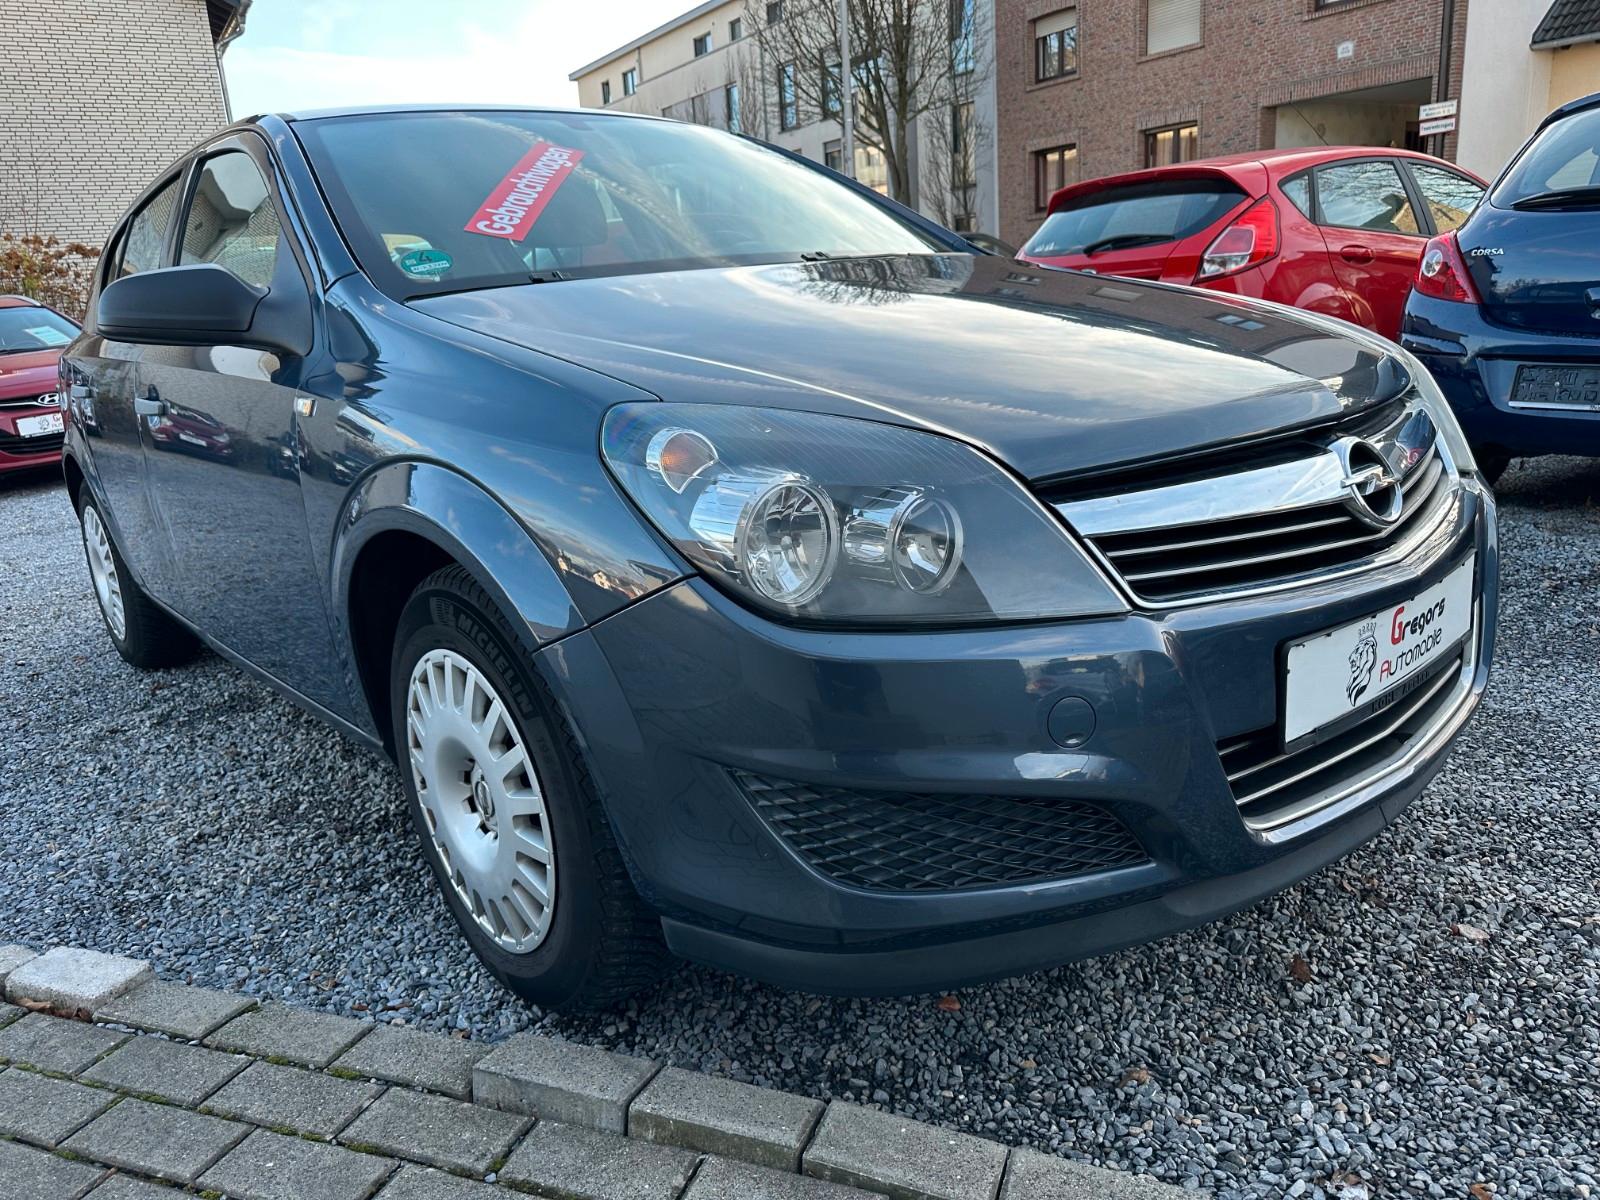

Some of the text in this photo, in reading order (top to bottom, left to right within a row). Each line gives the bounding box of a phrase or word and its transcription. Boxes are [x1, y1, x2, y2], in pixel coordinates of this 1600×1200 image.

[476, 147, 573, 235] Gebrauchtwagen
[419, 251, 432, 262] 4
[1471, 248, 1504, 257] CORSA
[1391, 598, 1446, 646] Gregors
[457, 613, 535, 713] MICHELIN
